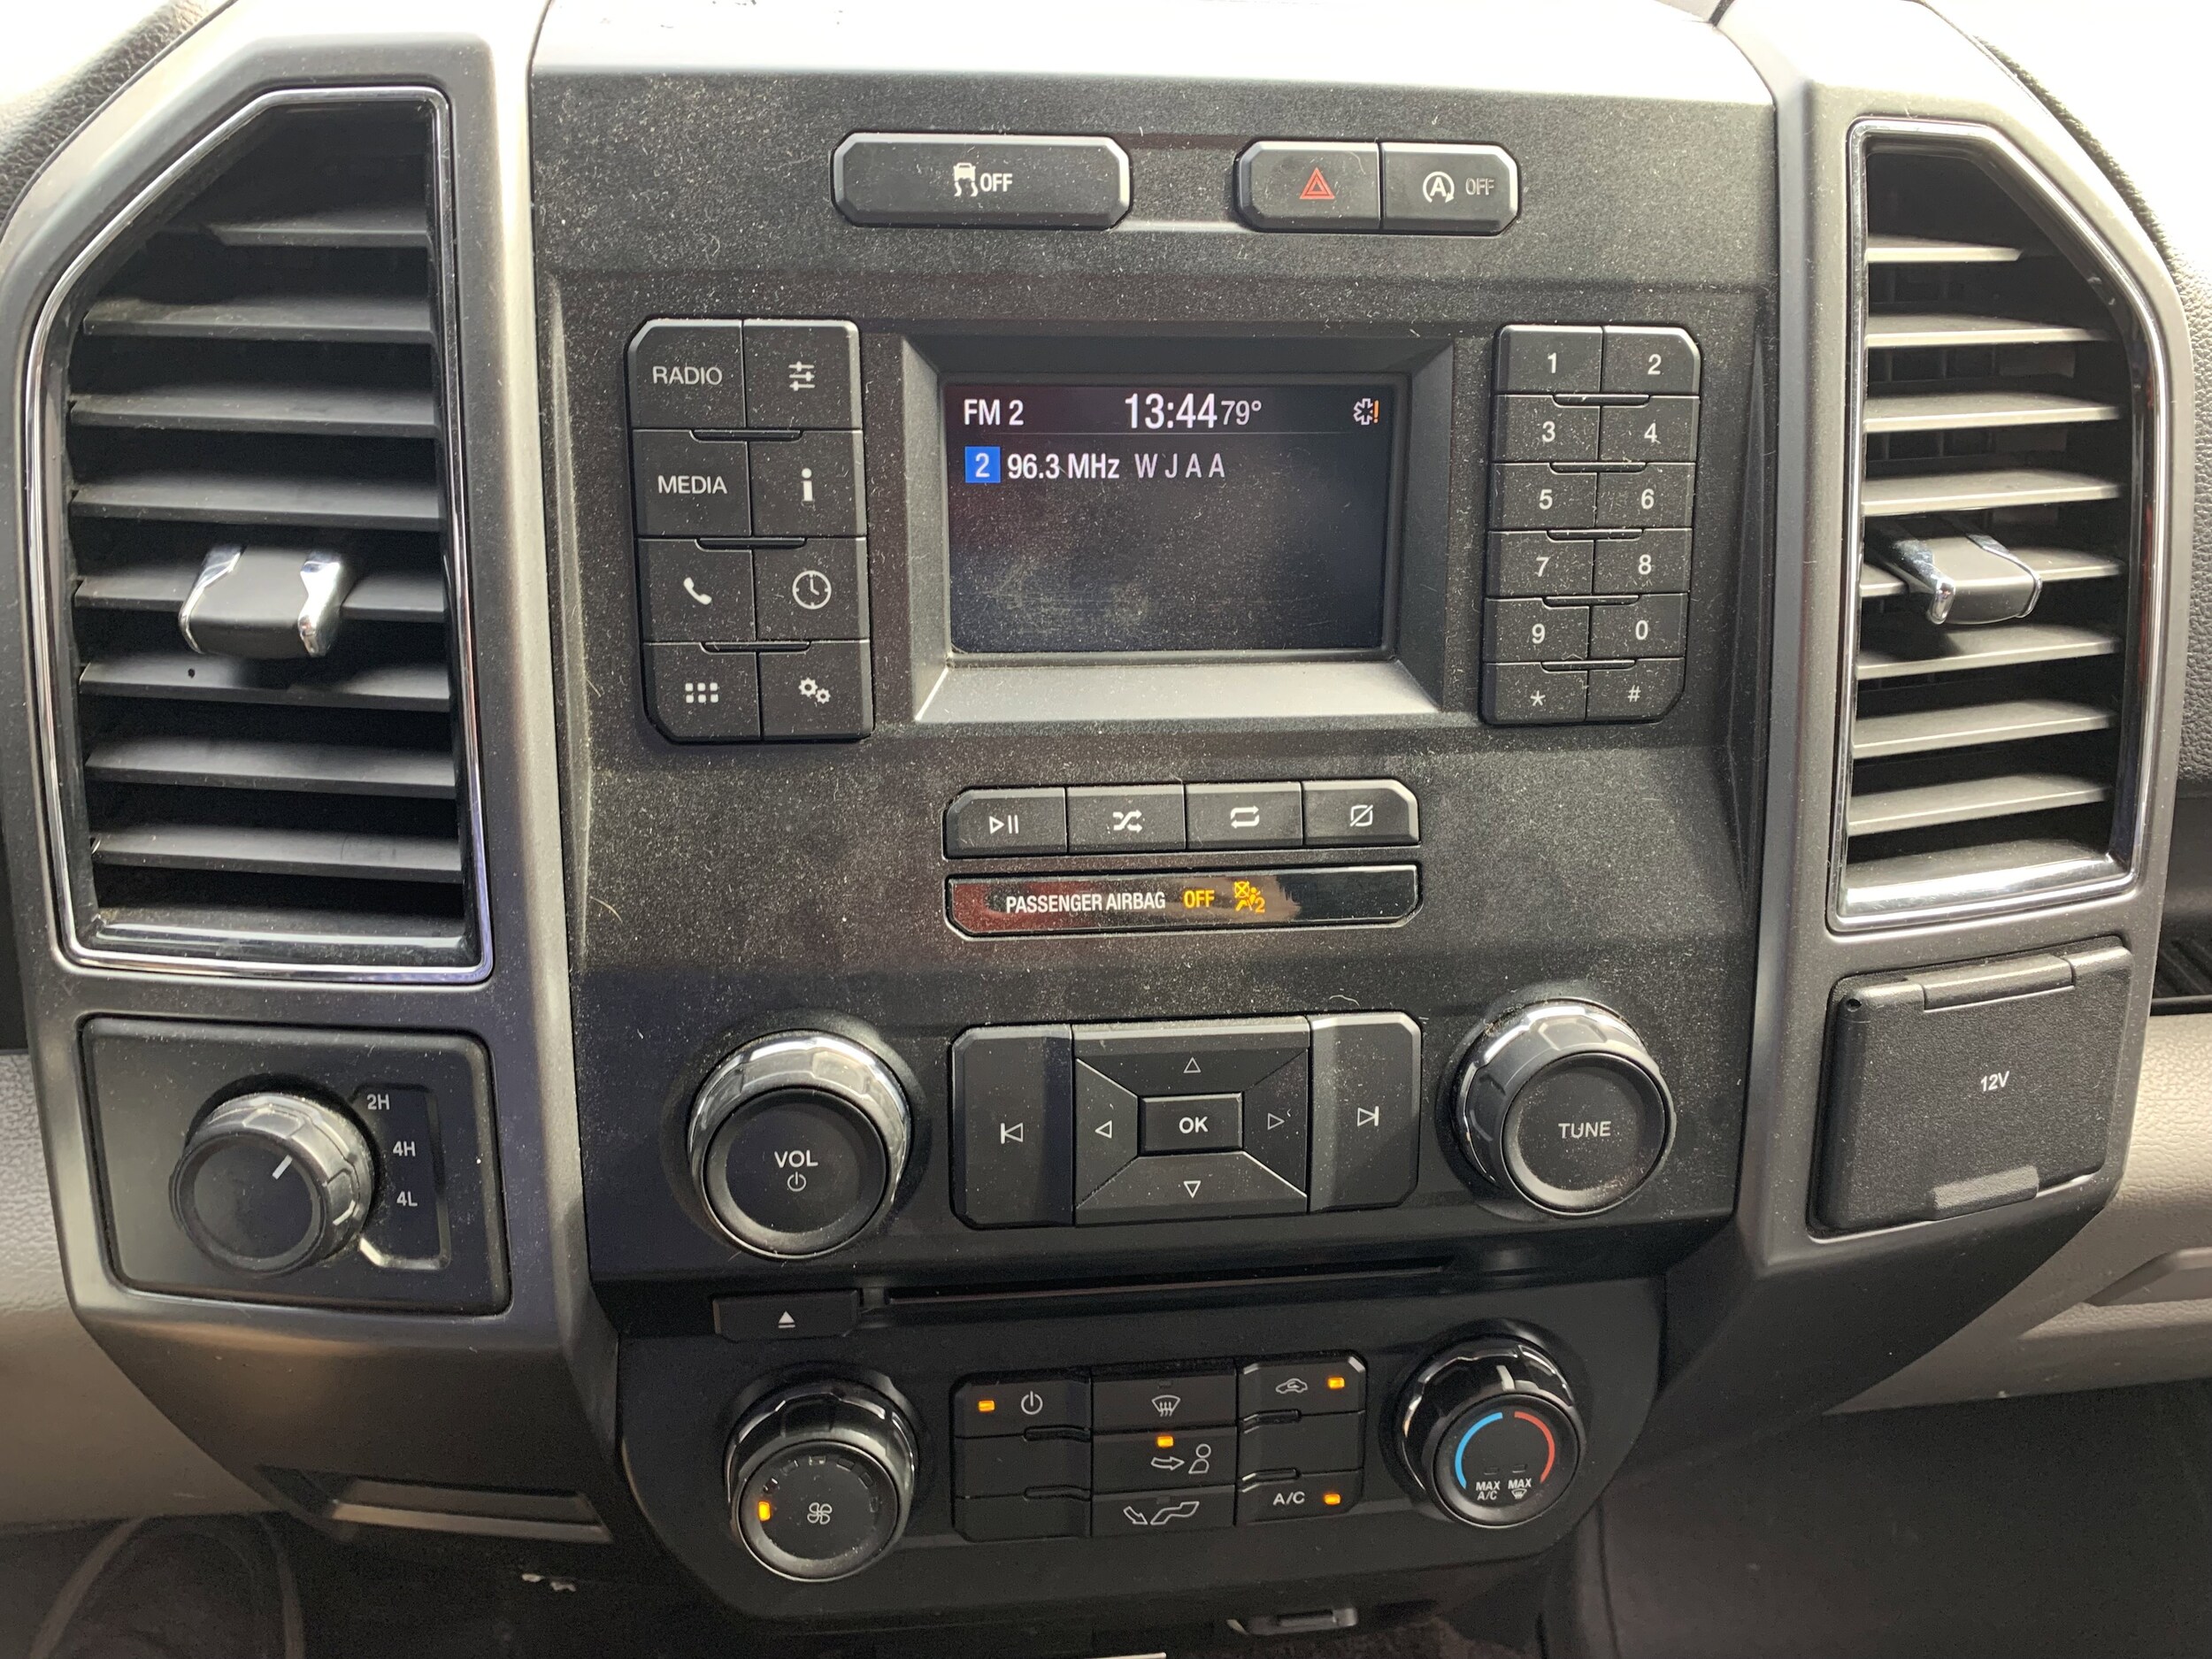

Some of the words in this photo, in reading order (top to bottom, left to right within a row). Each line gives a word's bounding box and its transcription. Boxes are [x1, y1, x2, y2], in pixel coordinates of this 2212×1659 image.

[980, 173, 1013, 192] OFF
[1465, 177, 1495, 196] OFF
[1547, 352, 1557, 374] 1
[1647, 353, 1662, 375] 2
[652, 366, 723, 385] RADIO
[964, 398, 1001, 426] FM
[1009, 399, 1025, 426] 2
[1125, 393, 1217, 429] 13:44
[1541, 420, 1555, 443] 3
[1643, 422, 1658, 442] 4
[975, 452, 990, 478] 2
[1007, 453, 1061, 480] 96.3
[1068, 453, 1120, 479] MHz
[657, 474, 728, 495] MEDIA
[1539, 488, 1553, 511] 5
[1640, 488, 1655, 510] 6
[1535, 556, 1550, 578] 7
[1638, 554, 1652, 575] 8
[1532, 623, 1546, 644] 9
[1006, 893, 1102, 915] PASSENGER
[1105, 891, 1166, 911] AIRBAG
[1183, 889, 1215, 909] OFF
[1980, 1071, 2010, 1093] 12V
[366, 1094, 390, 1110] 2H
[1179, 1116, 1209, 1134] OK
[1557, 1120, 1612, 1140] TUNE
[392, 1141, 416, 1157] 4H
[773, 1149, 818, 1169] VOL
[396, 1191, 419, 1207] 4L
[1475, 1480, 1501, 1491] MAX
[1508, 1478, 1532, 1489] MAX
[1272, 1491, 1306, 1506] A/C
[1477, 1490, 1498, 1501] A/C
